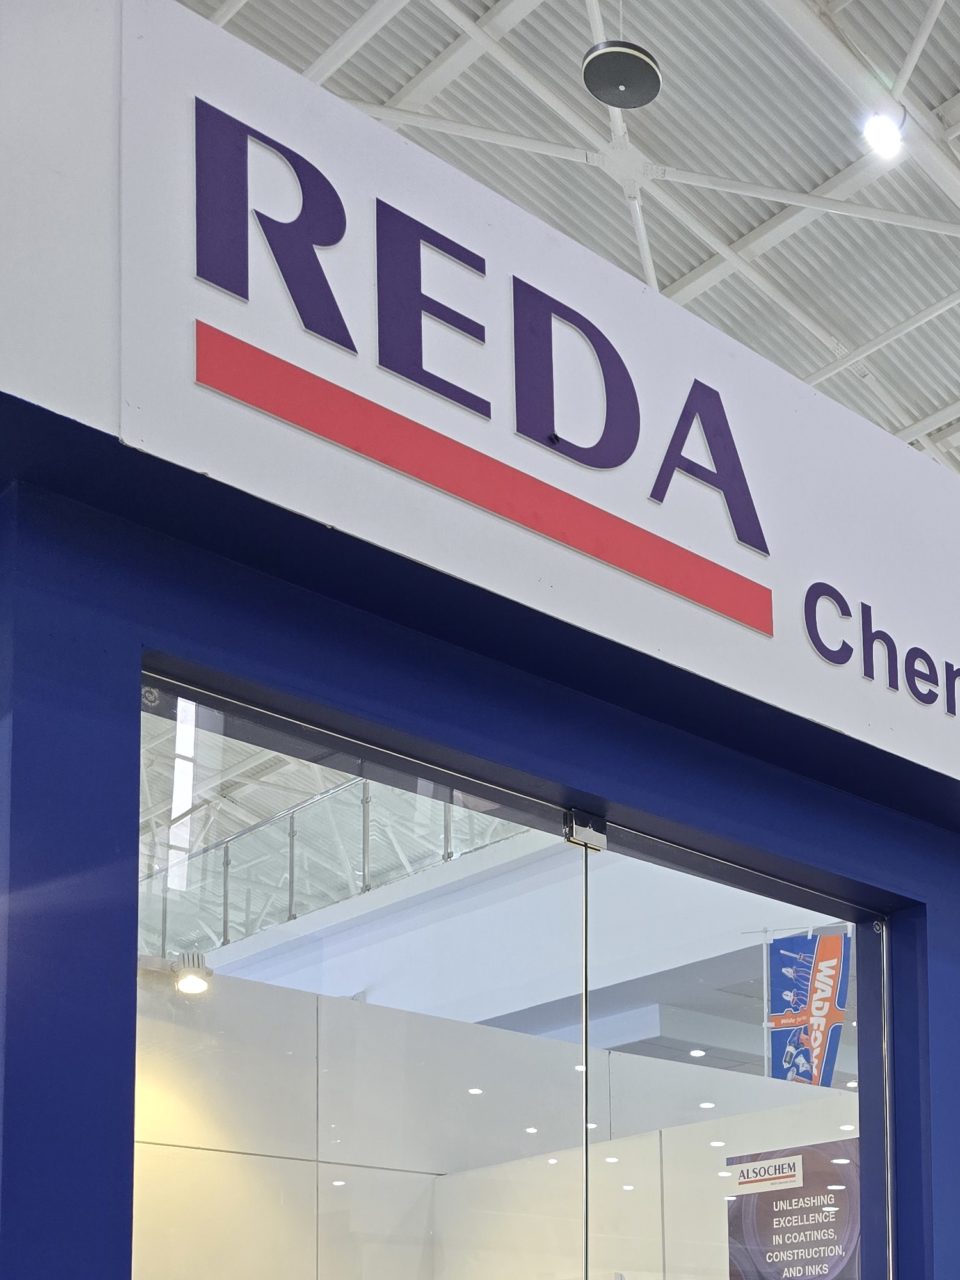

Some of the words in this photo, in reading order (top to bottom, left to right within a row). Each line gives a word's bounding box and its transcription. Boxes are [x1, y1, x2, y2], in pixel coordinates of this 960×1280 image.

[194, 95, 771, 558] REDA
[738, 1161, 797, 1181] ALSOCHEM
[773, 1193, 835, 1212] UNLEASHING
[773, 1211, 836, 1229] EXCELLENCE
[772, 1234, 783, 1245] IN
[785, 1228, 838, 1245] COATINGS,
[766, 1244, 846, 1263] CONSTRUCTION,
[782, 1265, 804, 1278] AND
[805, 1263, 829, 1277] INKS
